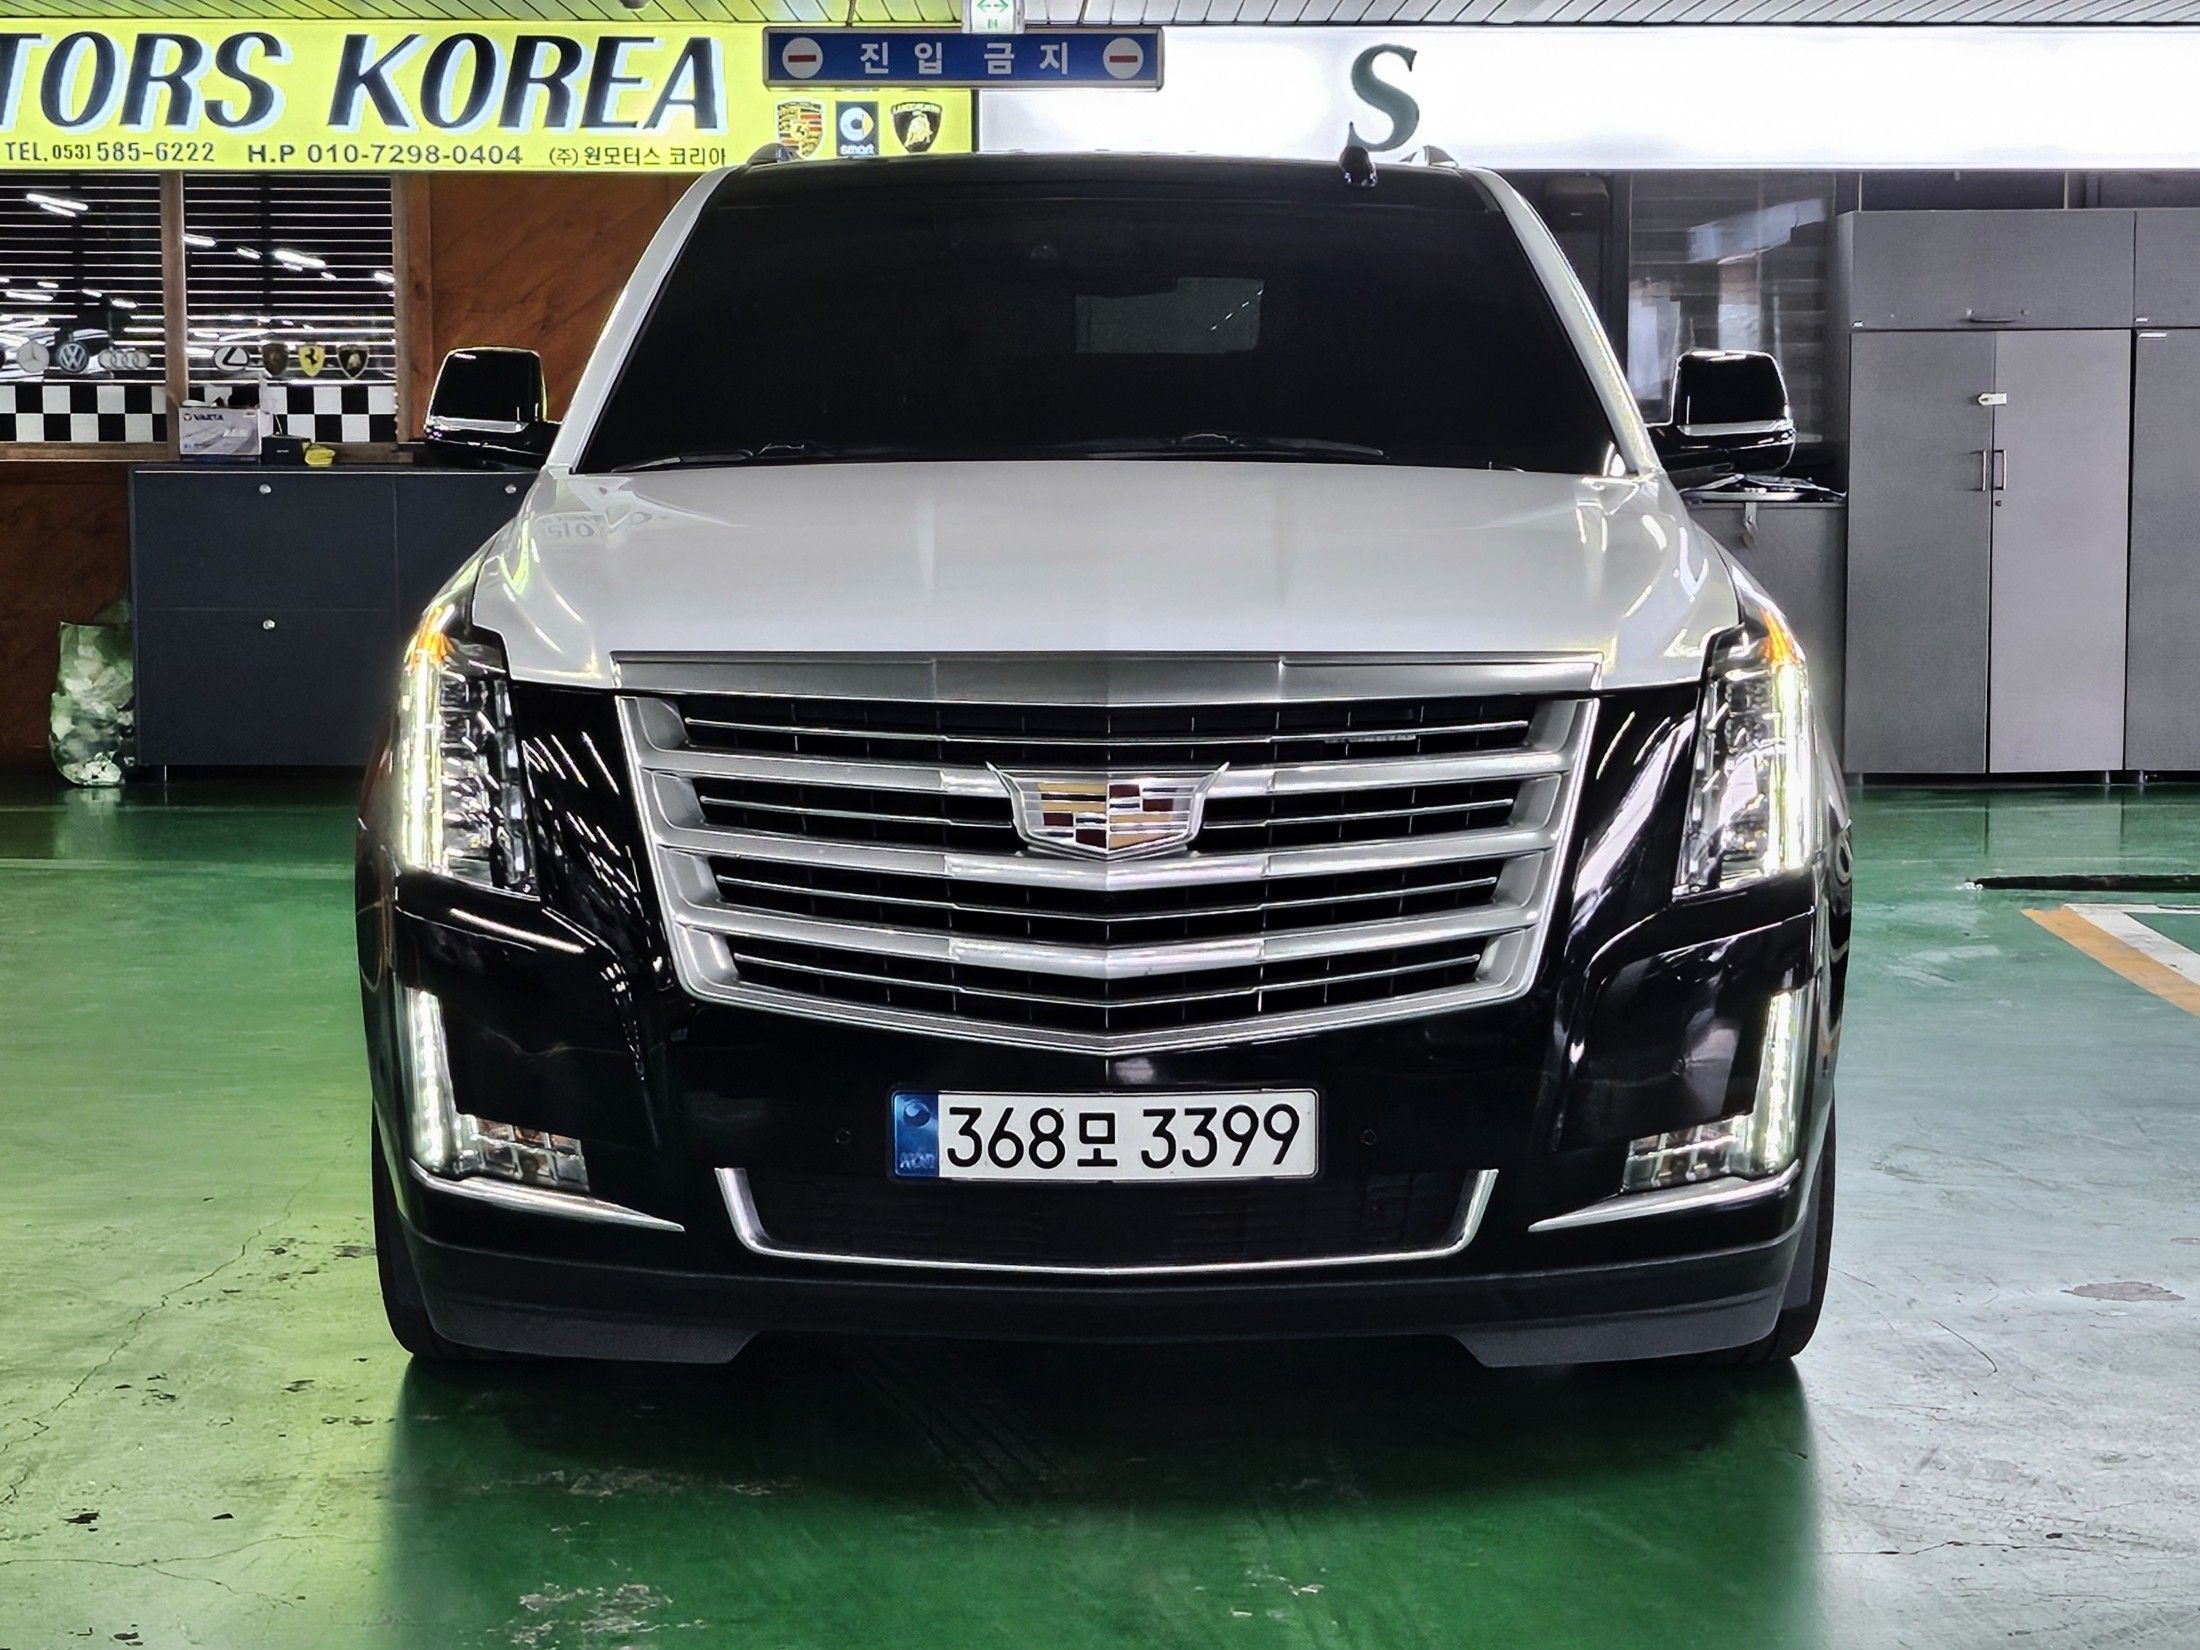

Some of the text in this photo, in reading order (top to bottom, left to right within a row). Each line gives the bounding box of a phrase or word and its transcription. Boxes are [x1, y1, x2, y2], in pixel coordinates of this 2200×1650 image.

[327, 33, 719, 128] KOREA
[860, 41, 1069, 75] 진입 금지
[1347, 43, 1420, 153] S
[307, 144, 523, 165] 010-7298-0404
[669, 147, 725, 166] 코리아
[947, 1103, 1301, 1170] 368모 3399
